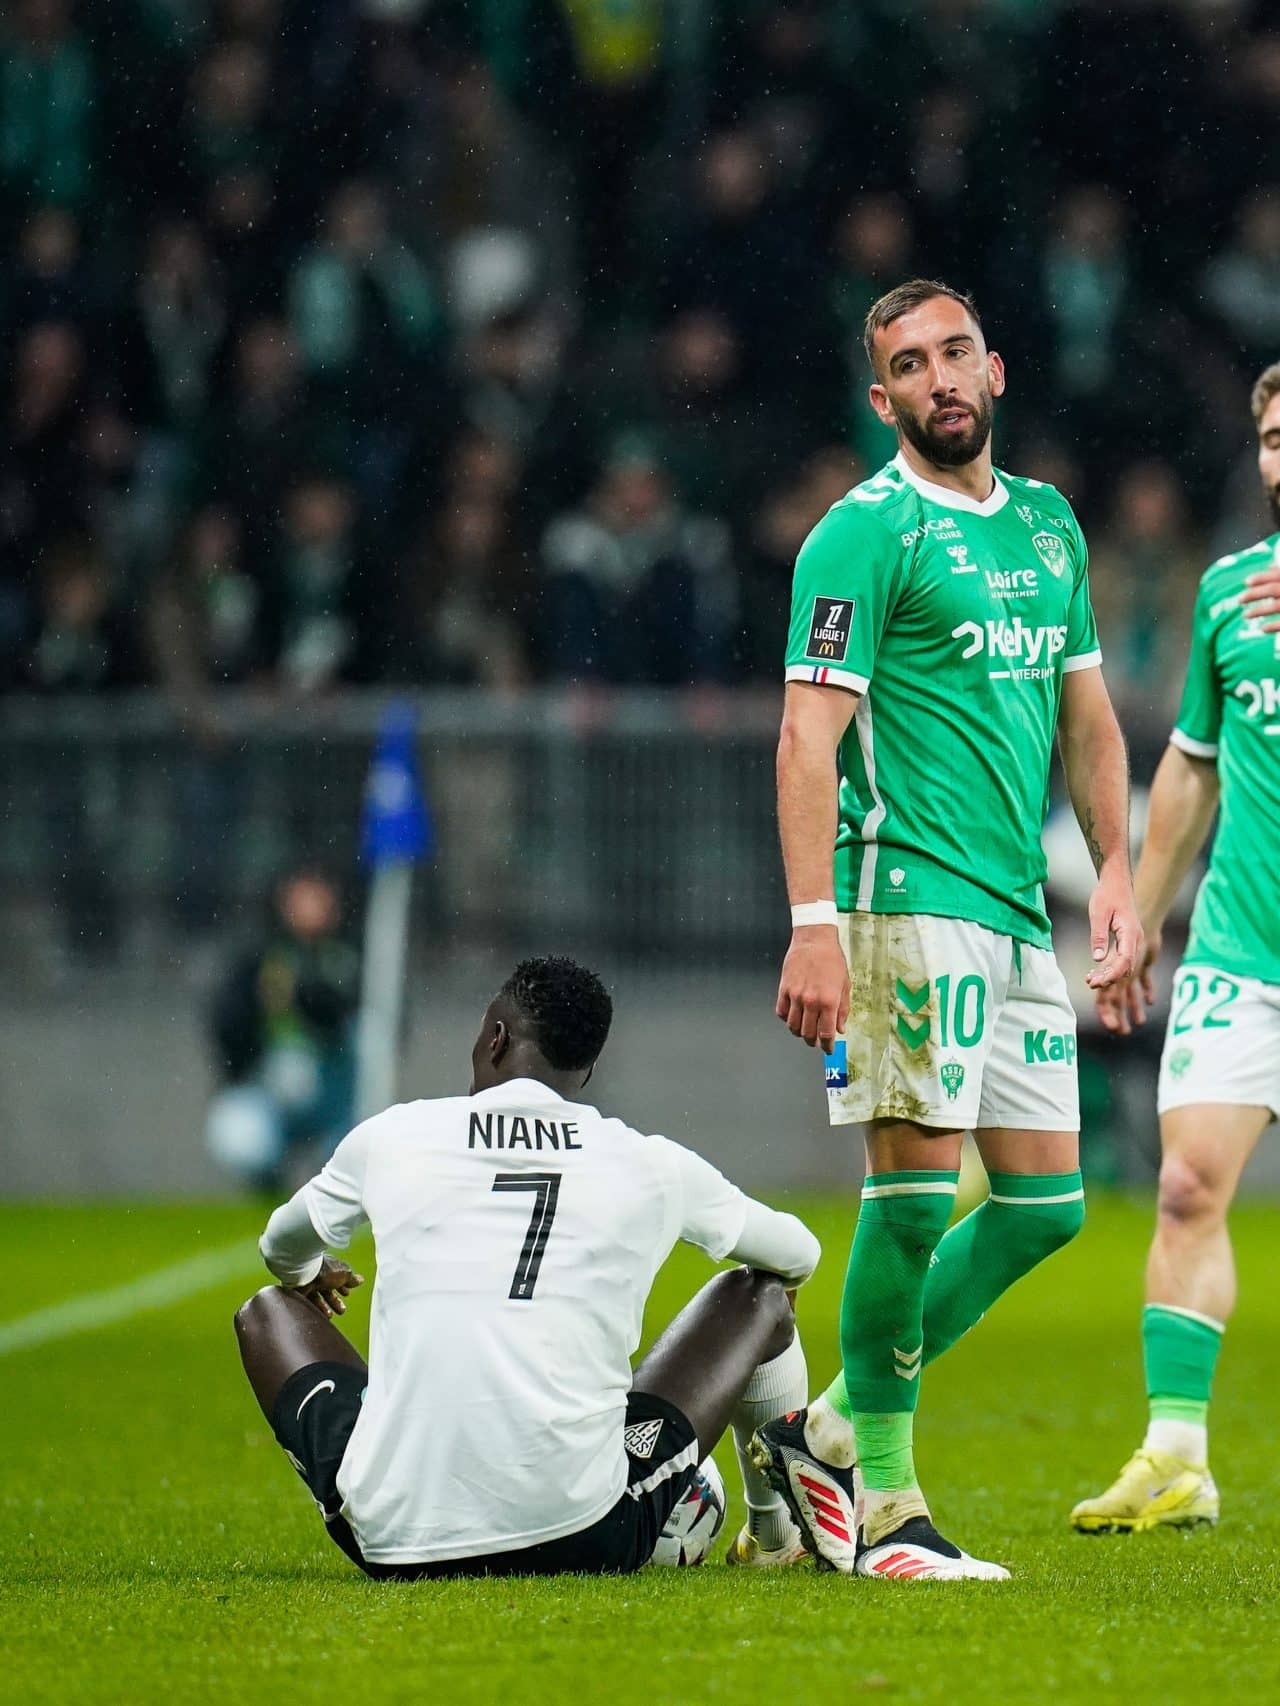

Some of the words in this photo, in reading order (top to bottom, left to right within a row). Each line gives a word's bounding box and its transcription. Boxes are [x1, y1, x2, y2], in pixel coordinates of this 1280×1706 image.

[984, 569, 1038, 589] Loire
[814, 628, 840, 641] LIGUE
[985, 617, 1068, 666] Kelyps
[935, 974, 986, 1048] 10
[1174, 974, 1240, 1035] 22
[468, 1111, 583, 1150] NIANE
[491, 1172, 563, 1300] 7
